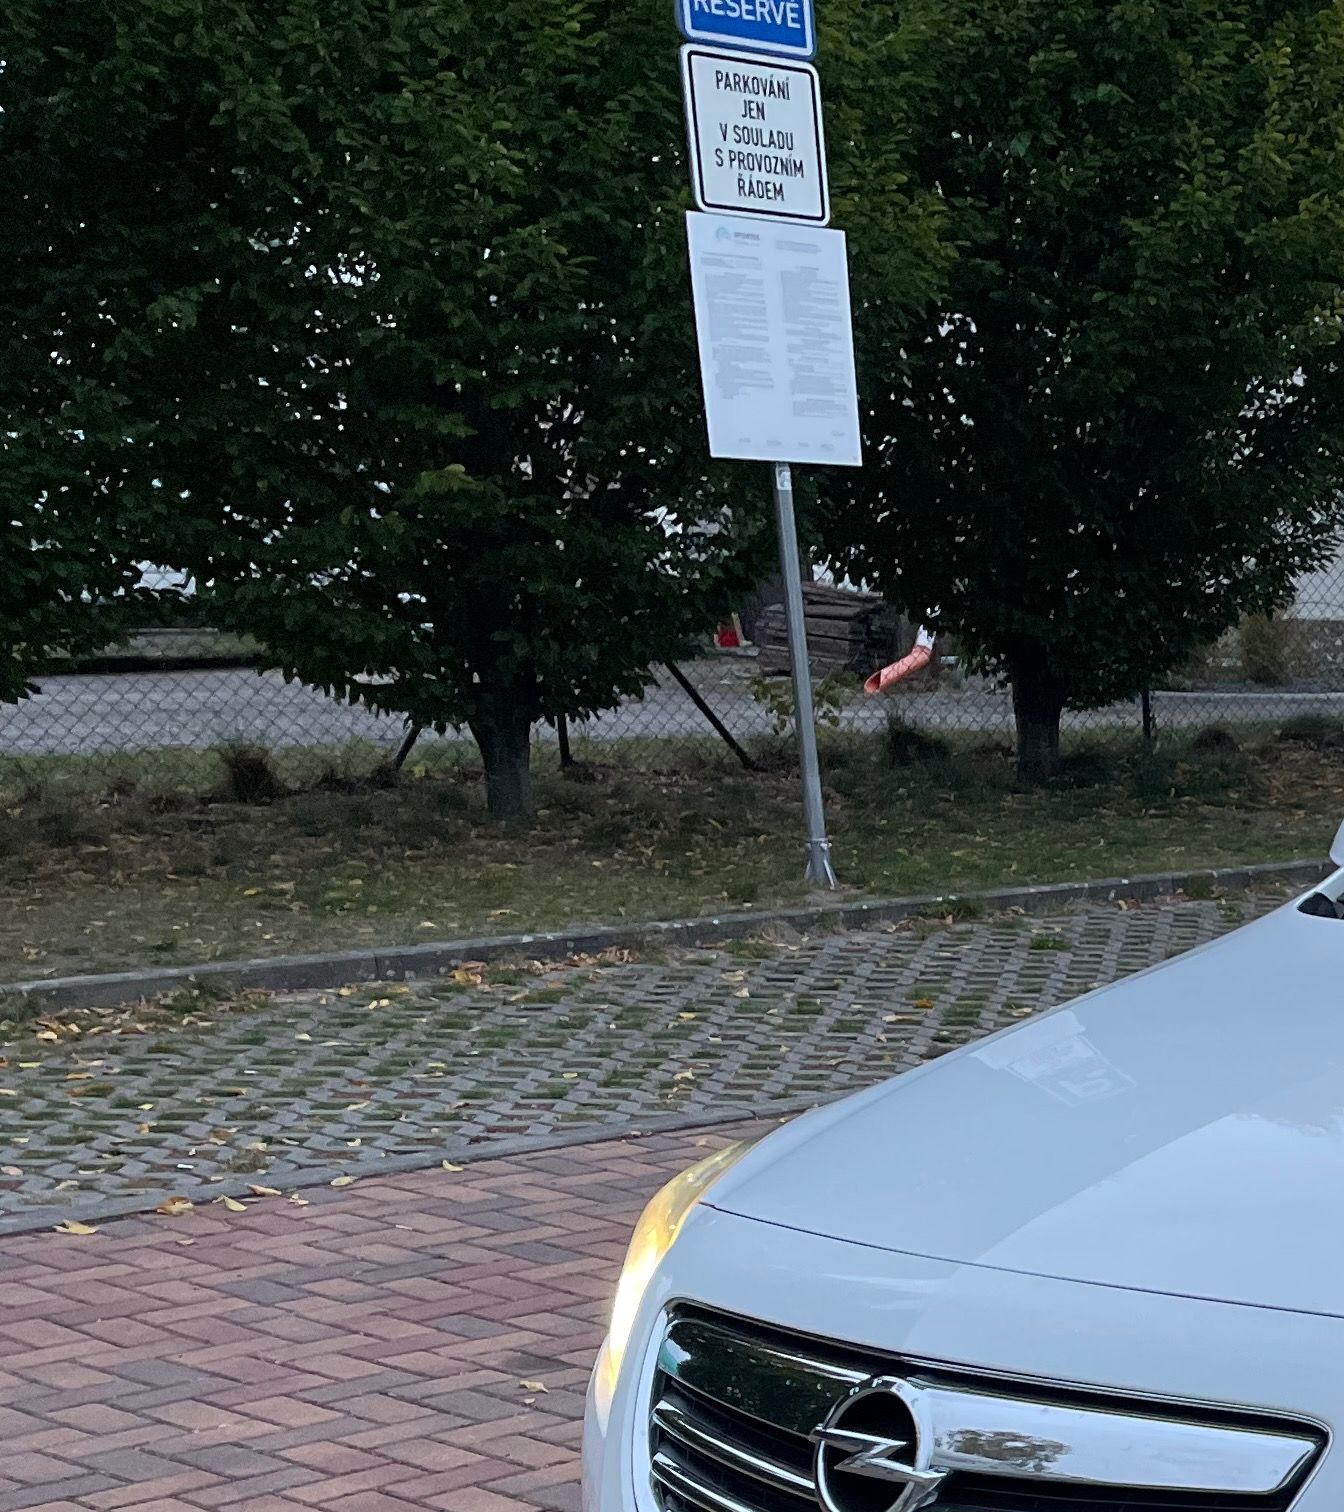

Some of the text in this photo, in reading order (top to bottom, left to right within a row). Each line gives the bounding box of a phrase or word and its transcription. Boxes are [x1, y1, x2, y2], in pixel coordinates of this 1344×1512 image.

[715, 70, 790, 100] PARKOVÁNÍ
[741, 100, 766, 121] JEN
[719, 123, 794, 151] V SOULADU
[715, 148, 805, 178] S PROVOZNÍM
[737, 173, 785, 201] ŘÁDEM
